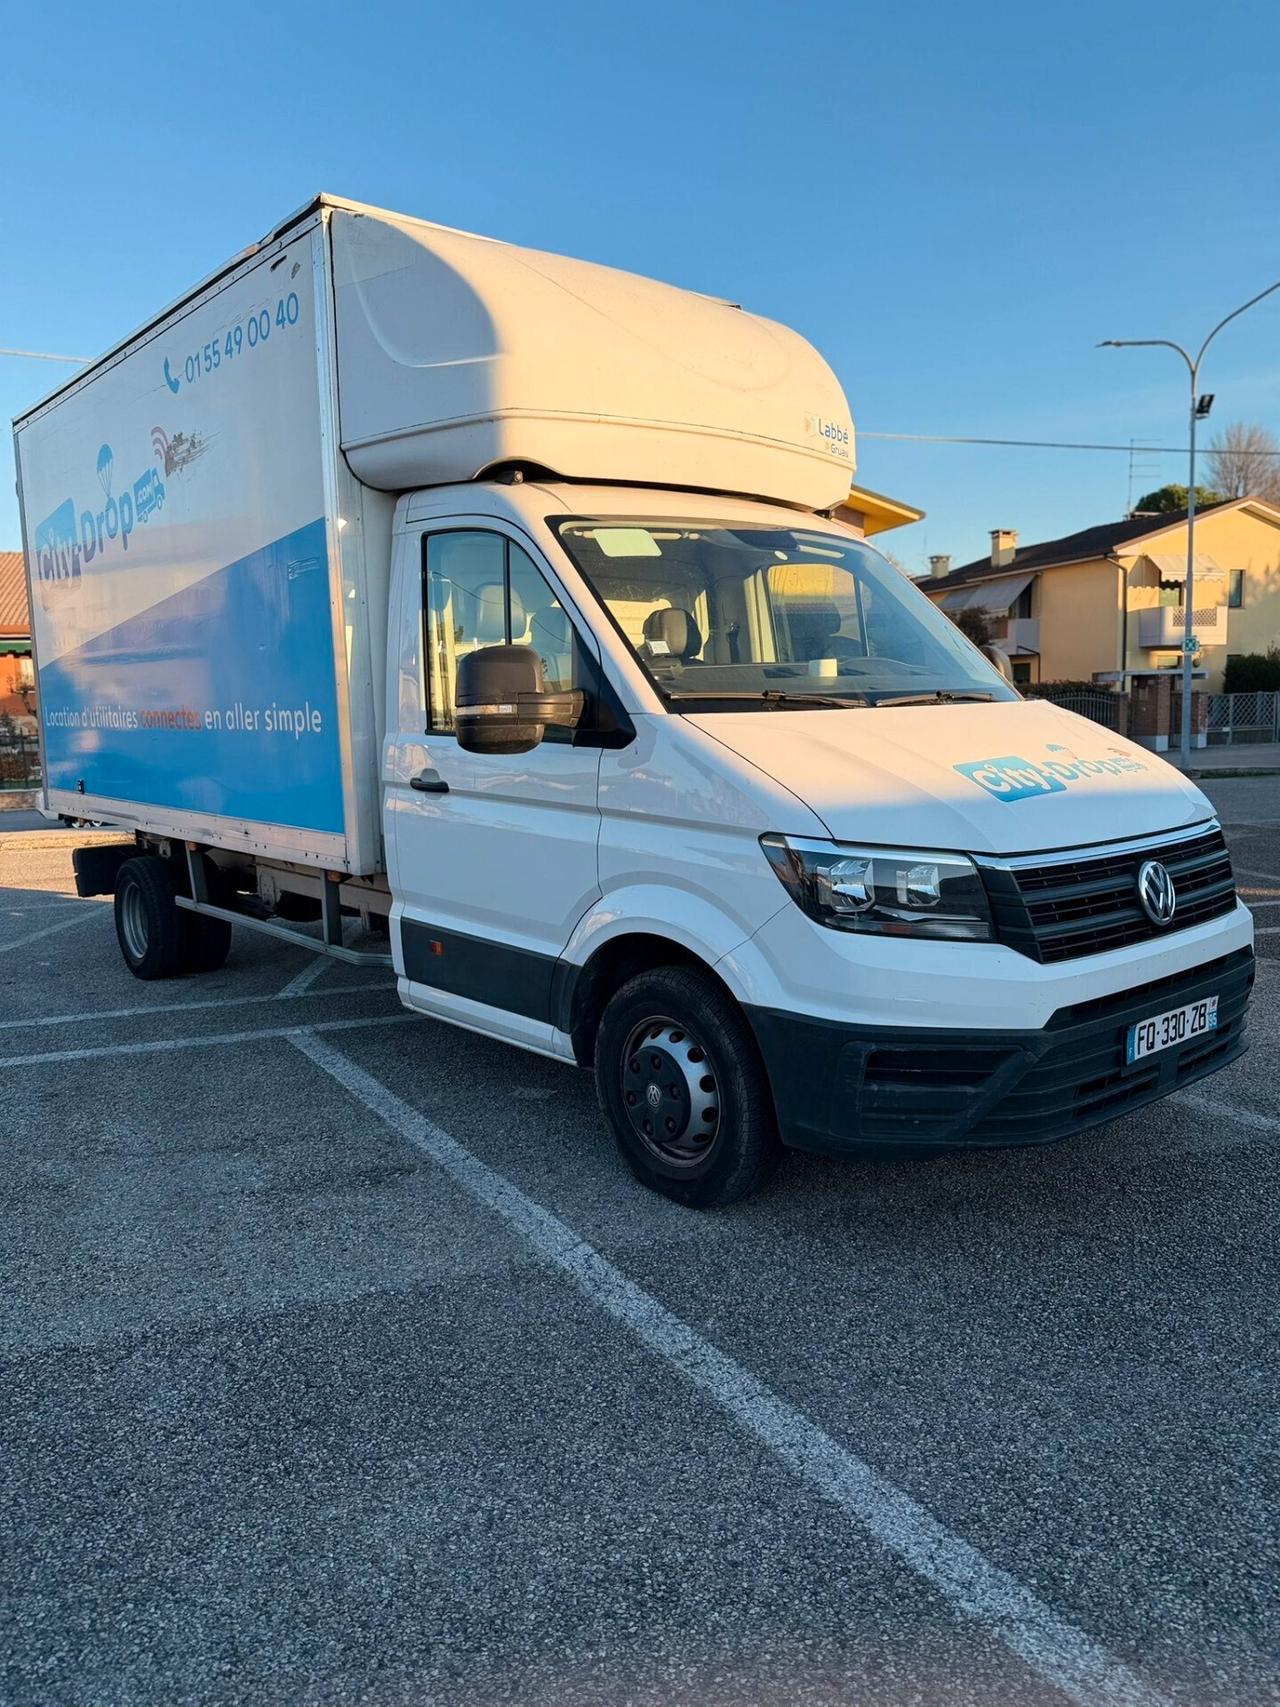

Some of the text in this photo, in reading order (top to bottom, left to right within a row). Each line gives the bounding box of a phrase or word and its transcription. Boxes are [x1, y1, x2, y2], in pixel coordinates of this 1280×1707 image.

[185, 292, 299, 383] 01 55 49 00 40
[818, 418, 849, 445] Labbé
[45, 706, 80, 728] Location
[81, 705, 138, 729] d'utilitaires
[204, 709, 222, 731] en
[225, 702, 260, 732] aller
[264, 701, 322, 740] simple
